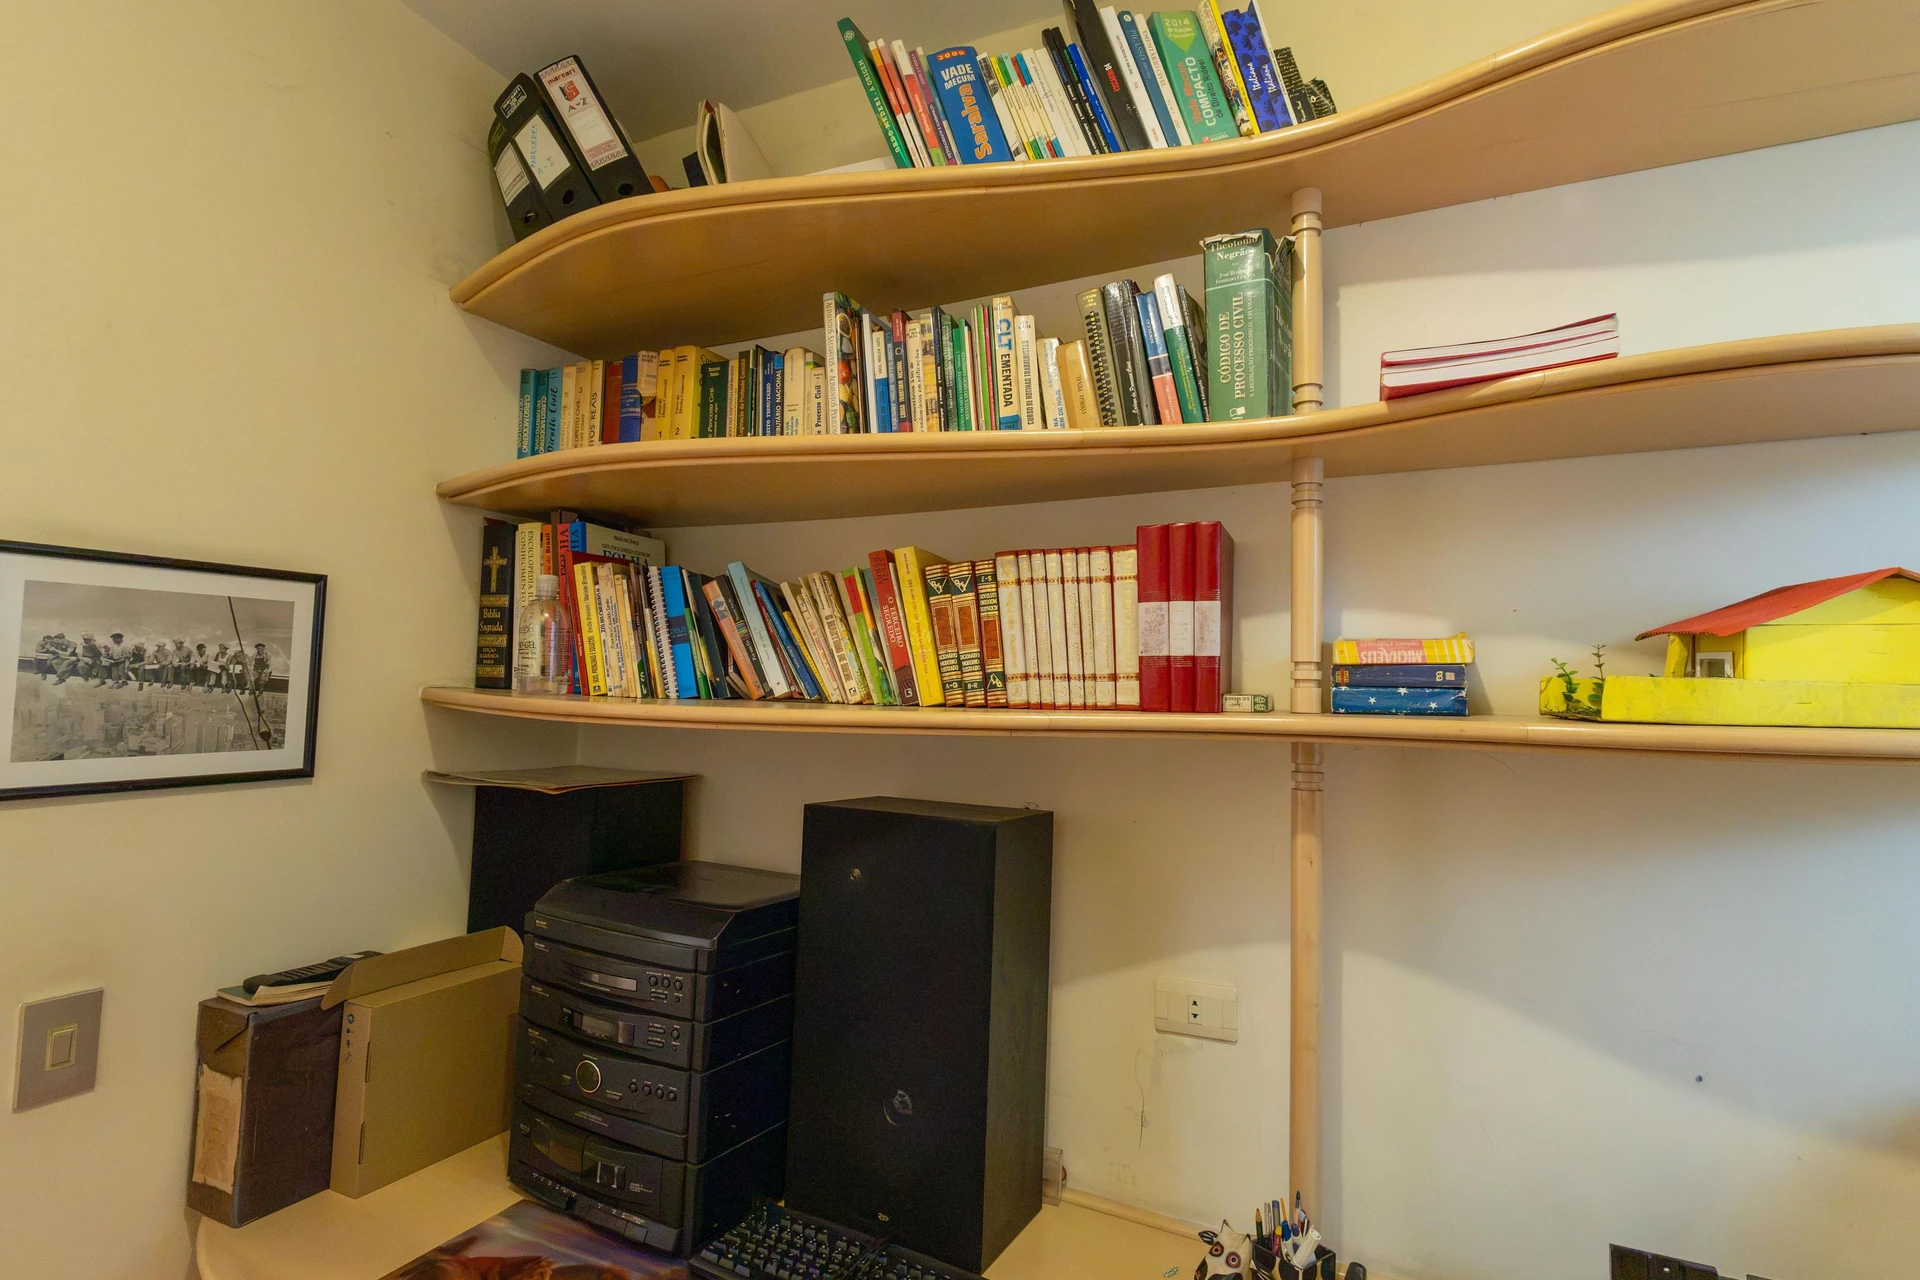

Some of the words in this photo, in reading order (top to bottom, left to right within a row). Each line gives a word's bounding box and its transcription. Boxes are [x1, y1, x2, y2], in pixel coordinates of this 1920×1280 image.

[1165, 18, 1190, 27] 2014
[1130, 29, 1146, 61] PICASSO
[1141, 29, 1160, 68] EMENTÁRIO
[1155, 67, 1167, 88] CÍVEL
[858, 59, 873, 86] ORIGEM
[941, 64, 974, 81] VADE
[944, 74, 976, 90] MECUM
[1198, 58, 1211, 82] Rideel
[1185, 56, 1217, 127] COMPACTO
[1206, 83, 1220, 108] Direito
[1215, 108, 1224, 119] de
[1211, 238, 1257, 251] Theotonio
[1217, 248, 1251, 260] Negrão
[826, 301, 834, 335] ALIMENTOS
[1218, 311, 1230, 332] DE
[1232, 292, 1245, 328] CIVIL
[997, 319, 1012, 351] CLT
[1090, 311, 1101, 354] BRASILEIRA
[1022, 340, 1031, 377] TRABALHISTAS
[1219, 333, 1231, 384] CÓDIGO
[1233, 331, 1246, 400] PROCESSO
[829, 375, 837, 407] ALIMENTOS
[1000, 353, 1013, 408] EMENTADA
[1098, 357, 1108, 398] LITERATURA
[523, 394, 531, 416] CURSO
[590, 392, 598, 420] REAIS
[909, 385, 917, 421] comentários
[1057, 406, 1063, 416] DE
[522, 417, 530, 453] MODERNO
[658, 430, 662, 438] 1
[675, 427, 680, 436] 2
[873, 557, 885, 585] BERRY
[879, 556, 888, 583] STEVE
[887, 596, 895, 604] O
[480, 621, 503, 634] Sagrada
[882, 604, 896, 644] SEGREDO
[890, 605, 904, 649] TERCEIRO
[1360, 649, 1422, 664] MICHAELIS
